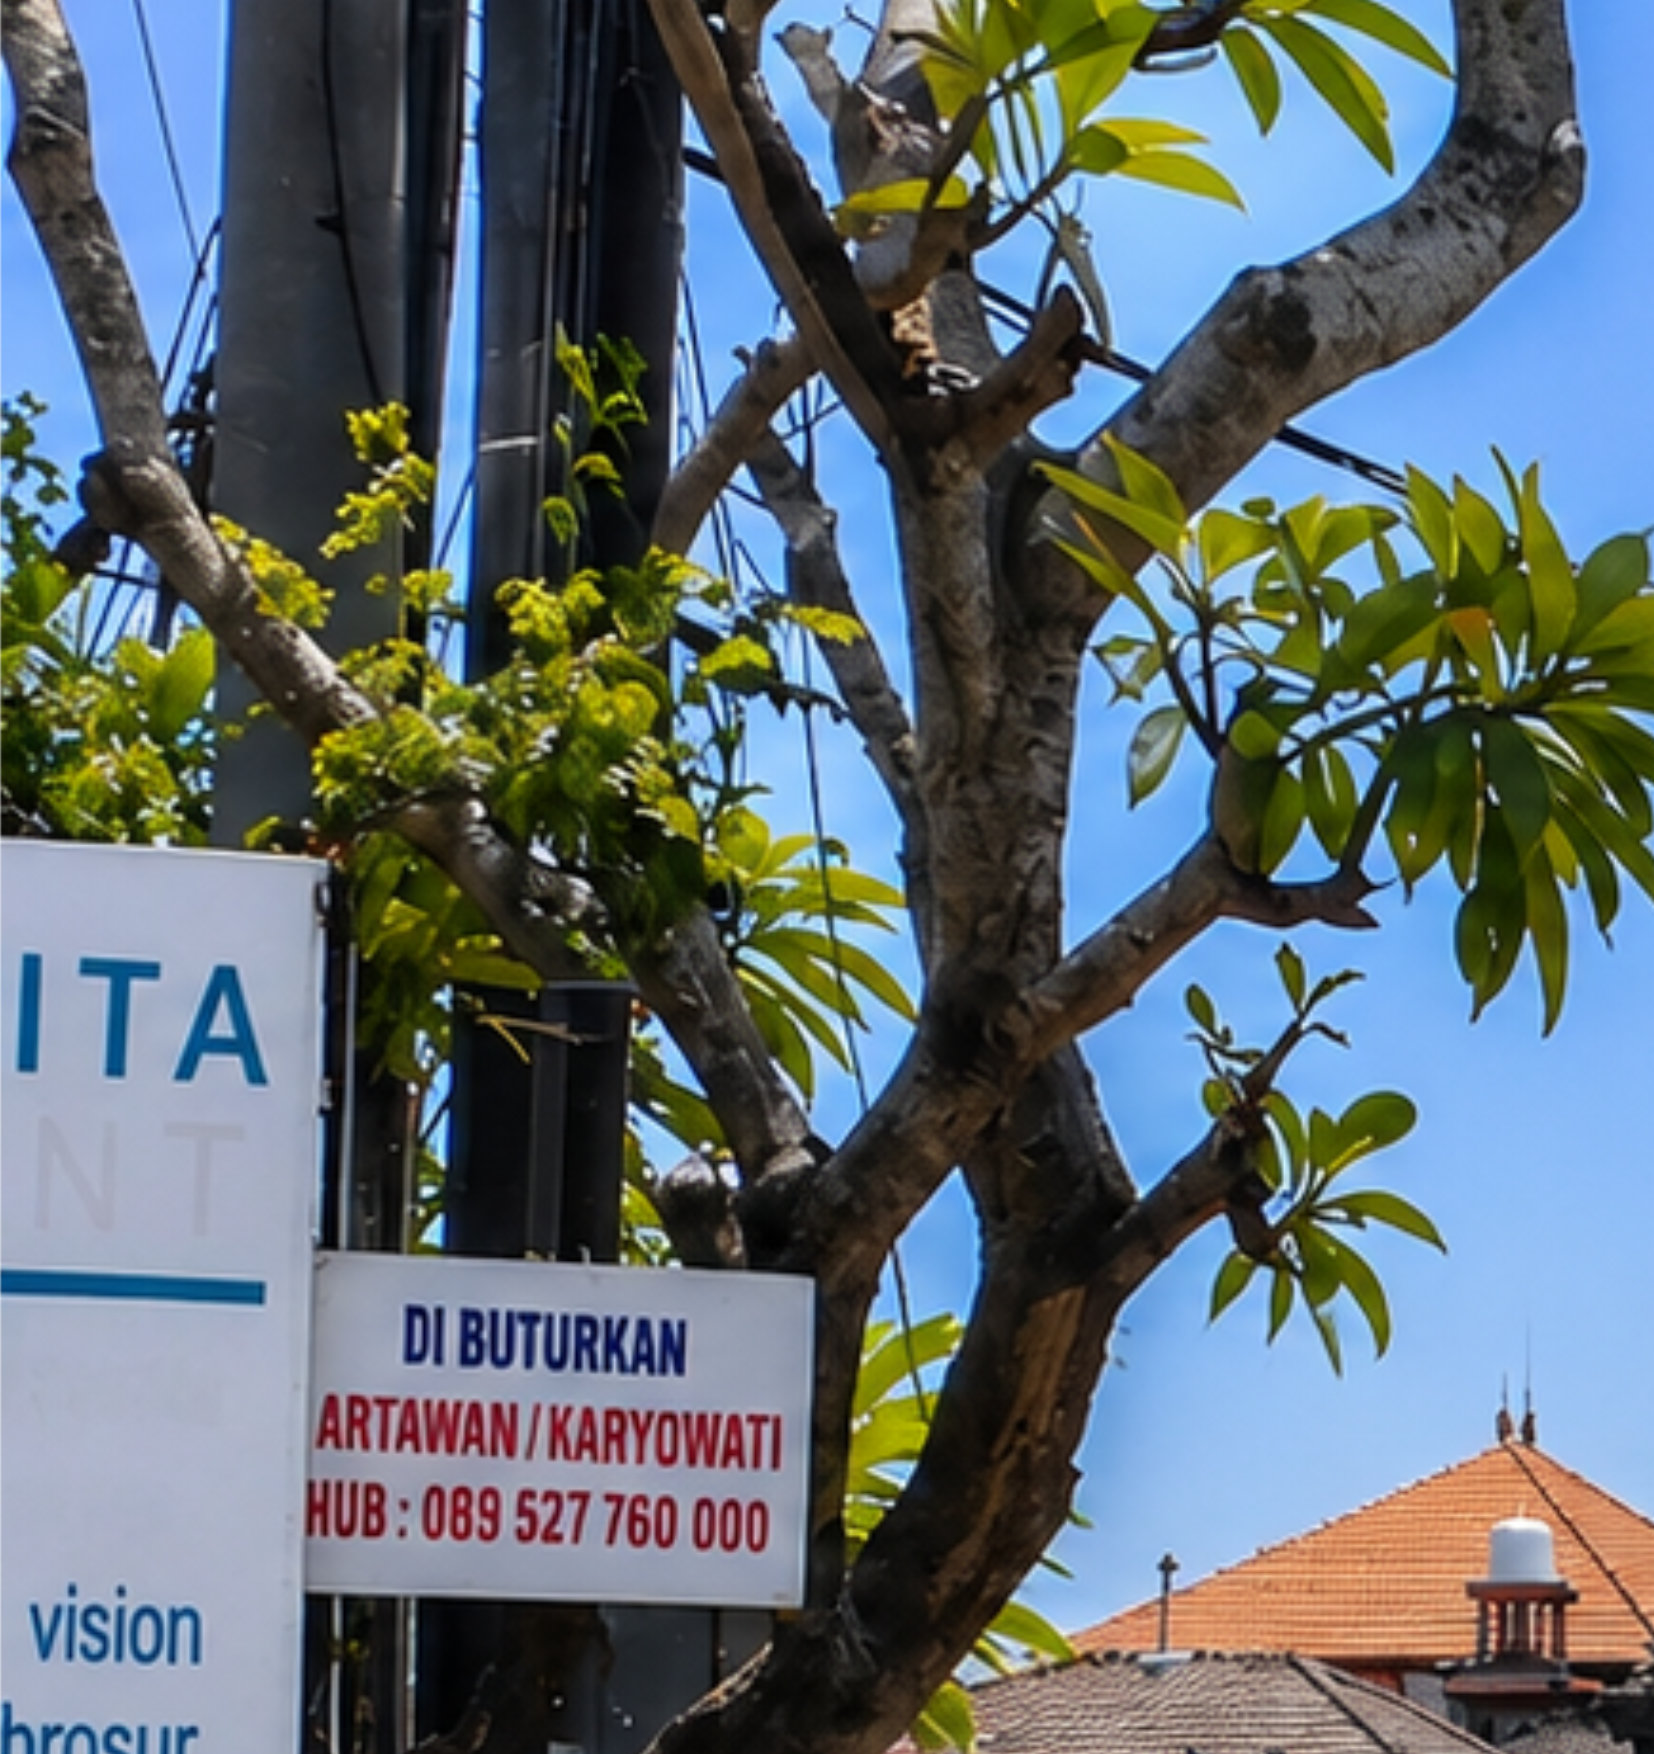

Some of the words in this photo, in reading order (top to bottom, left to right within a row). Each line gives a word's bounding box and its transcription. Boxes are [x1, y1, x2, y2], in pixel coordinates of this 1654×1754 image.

[17, 953, 268, 1086] ITA
[403, 1304, 445, 1366] DI
[459, 1307, 687, 1377] BUTURKAN
[315, 1393, 518, 1459] ARTAWAN
[548, 1404, 782, 1471] KARYOWATI
[422, 1485, 501, 1542] 089
[515, 1488, 591, 1545] 527
[603, 1493, 678, 1549] 760
[692, 1497, 769, 1553] 000
[30, 1583, 203, 1665] vision
